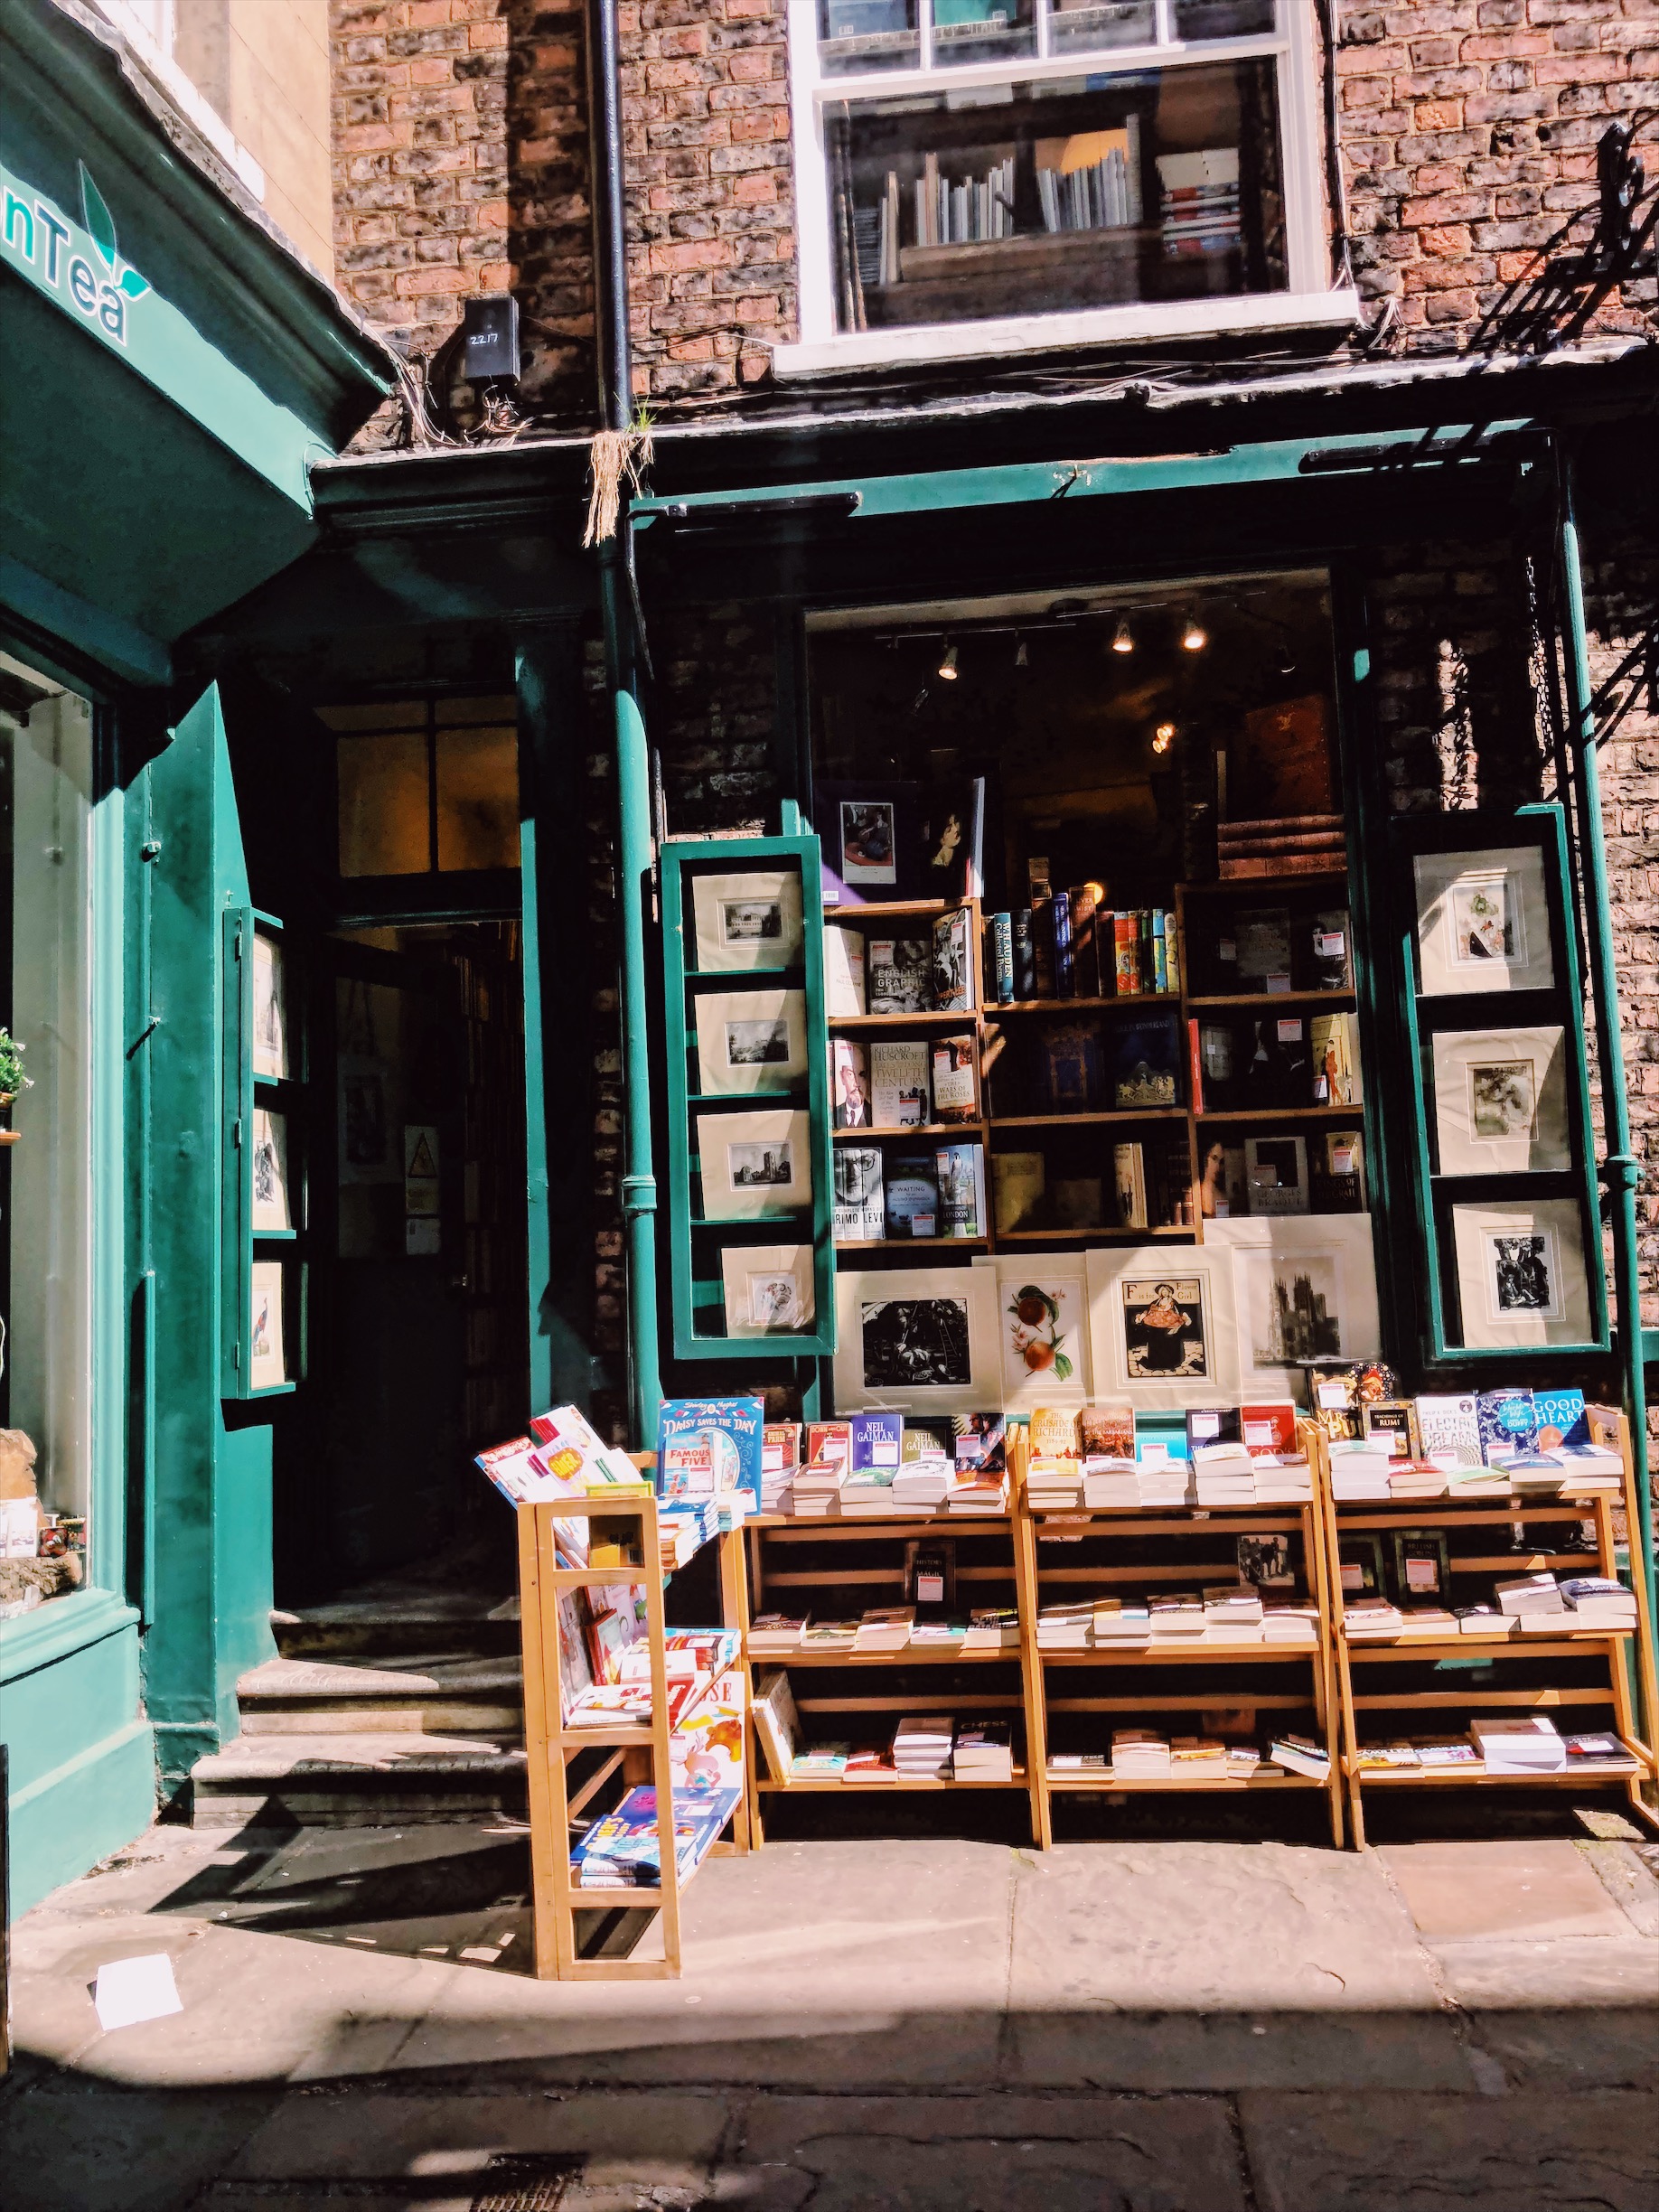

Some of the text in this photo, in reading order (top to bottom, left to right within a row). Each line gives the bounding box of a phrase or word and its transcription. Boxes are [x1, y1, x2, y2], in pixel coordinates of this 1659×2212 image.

[470, 333, 499, 345] 2217
[877, 969, 925, 979] ENGLISH
[877, 978, 925, 988] GRAPHIC
[874, 1045, 910, 1054] RICHARD
[874, 1052, 925, 1062] HUSCROFT
[875, 1067, 925, 1078] TWELFTH
[875, 1077, 923, 1088] CENTURY
[942, 1211, 968, 1219] LONDON
[1176, 1282, 1197, 1290] Flower
[1126, 1284, 1137, 1299] F
[1177, 1291, 1193, 1299] Girl
[683, 1401, 738, 1411] Shirley Hughes
[1532, 1398, 1582, 1413] GOOD
[1534, 1410, 1584, 1424] HEART
[663, 1418, 757, 1438] DAISY SAVES THE DAY
[866, 1421, 886, 1432] NEIL
[1033, 1419, 1069, 1428] CRUSADE
[1422, 1416, 1477, 1431] ELECTRIC
[857, 1431, 894, 1442] GAIMAN
[914, 1432, 933, 1442] NEIL
[1033, 1428, 1074, 1438] RICHARD
[767, 1435, 786, 1443] FARM
[1422, 1430, 1479, 1447] DREAMS
[905, 1440, 942, 1450] GAIMAN
[670, 1448, 710, 1458] FAMOUS
[681, 1457, 707, 1467] FIVE
[961, 1720, 1008, 1729] CHESS
